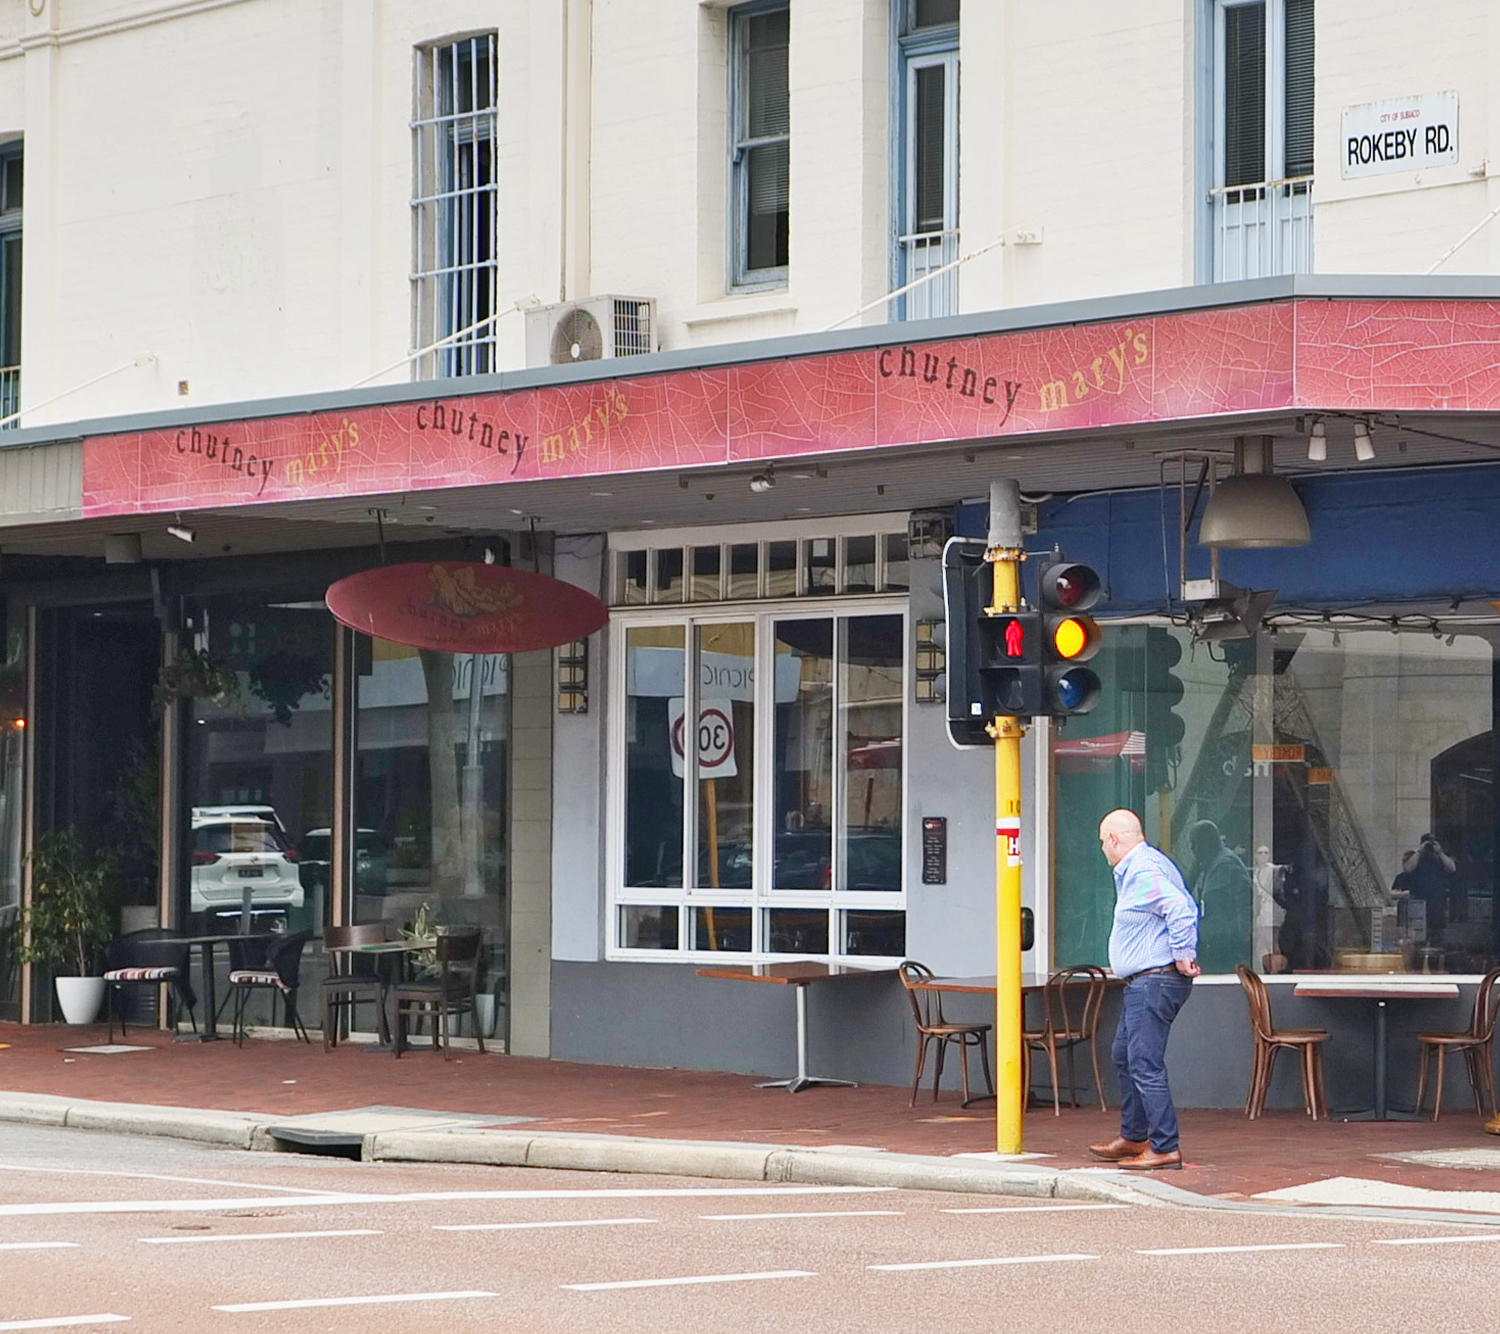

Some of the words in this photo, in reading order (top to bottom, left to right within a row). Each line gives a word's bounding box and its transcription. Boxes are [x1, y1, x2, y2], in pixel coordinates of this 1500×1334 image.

[1347, 128, 1417, 166] ROKEBY
[1425, 124, 1453, 155] RD.
[879, 345, 1022, 427] chutney
[1039, 328, 1149, 413] mary's
[175, 425, 274, 496] chutney
[285, 418, 361, 486] mary's
[416, 400, 530, 475] chutney
[542, 387, 629, 463] mary's
